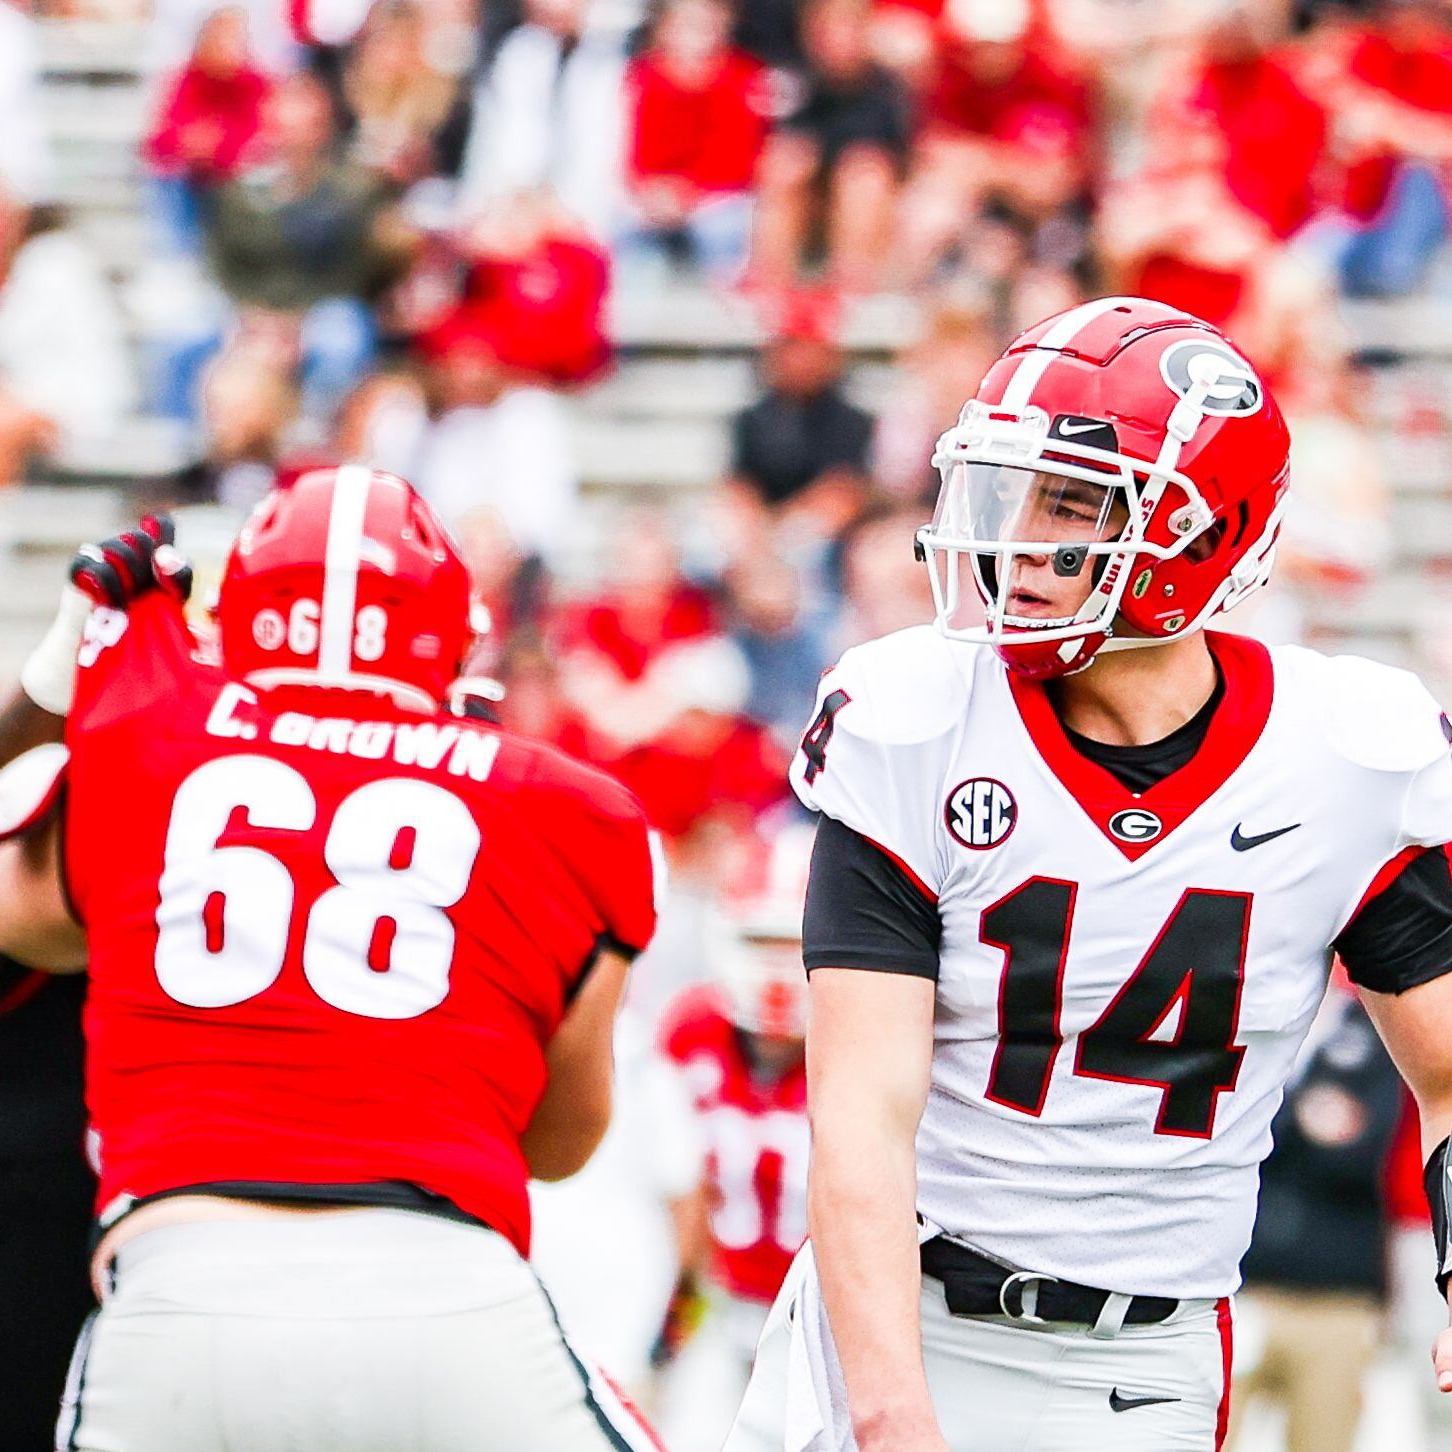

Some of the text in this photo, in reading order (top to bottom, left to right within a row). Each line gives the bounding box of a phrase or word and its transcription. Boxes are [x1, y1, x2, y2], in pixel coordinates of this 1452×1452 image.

[269, 711, 501, 783] BROWN
[950, 780, 1016, 846] SEC
[1113, 811, 1163, 840] G
[154, 753, 482, 1020] 68
[978, 874, 1254, 1140] 14
